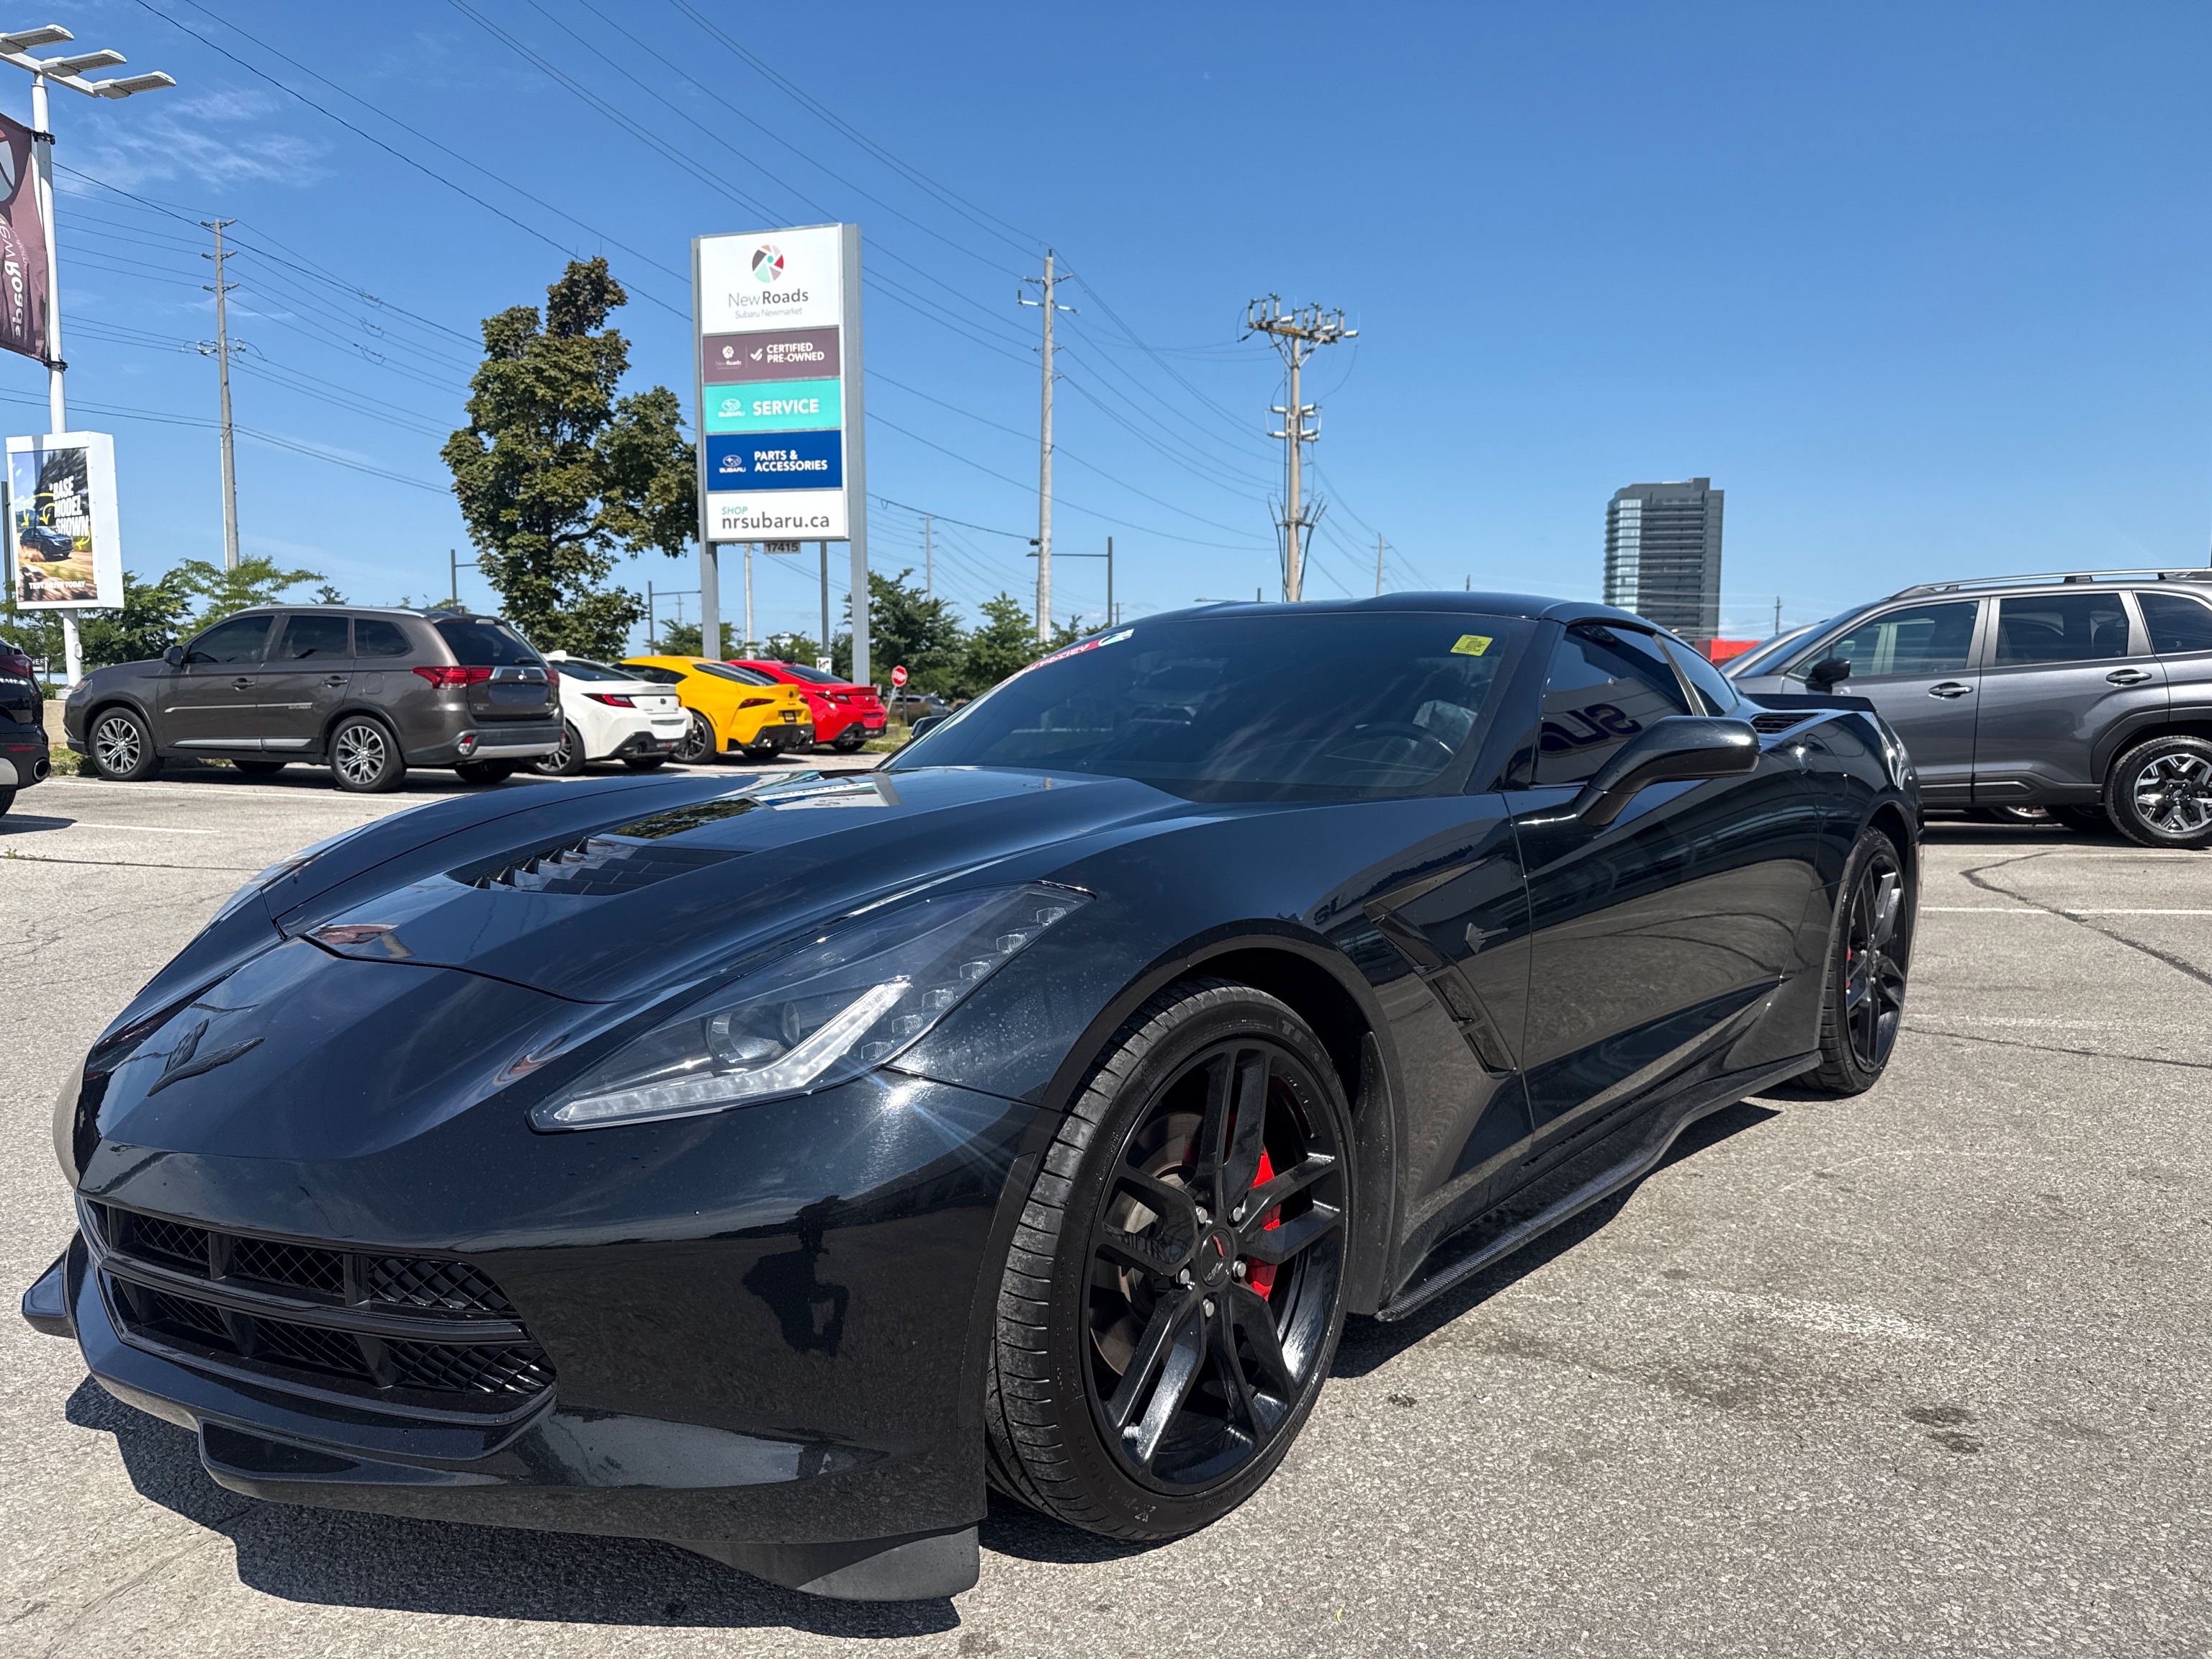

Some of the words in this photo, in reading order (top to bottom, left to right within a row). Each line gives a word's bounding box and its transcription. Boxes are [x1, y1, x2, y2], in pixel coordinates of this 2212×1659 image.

[735, 310, 760, 319] Subaru
[762, 307, 803, 317] Newmarket
[766, 342, 813, 354] CERTIFIED
[767, 351, 824, 363] PRE-OWNED
[752, 399, 819, 416] SERVICE
[754, 451, 786, 461] PARTS
[789, 450, 798, 460] &
[754, 460, 827, 472] ACCESSORIES
[54, 495, 82, 518] MODEL
[721, 506, 748, 515] SHOP
[55, 516, 89, 536] SHOWN
[722, 511, 830, 529] nrsubaru.ca
[766, 543, 799, 552] 17415
[893, 670, 907, 682] STOP
